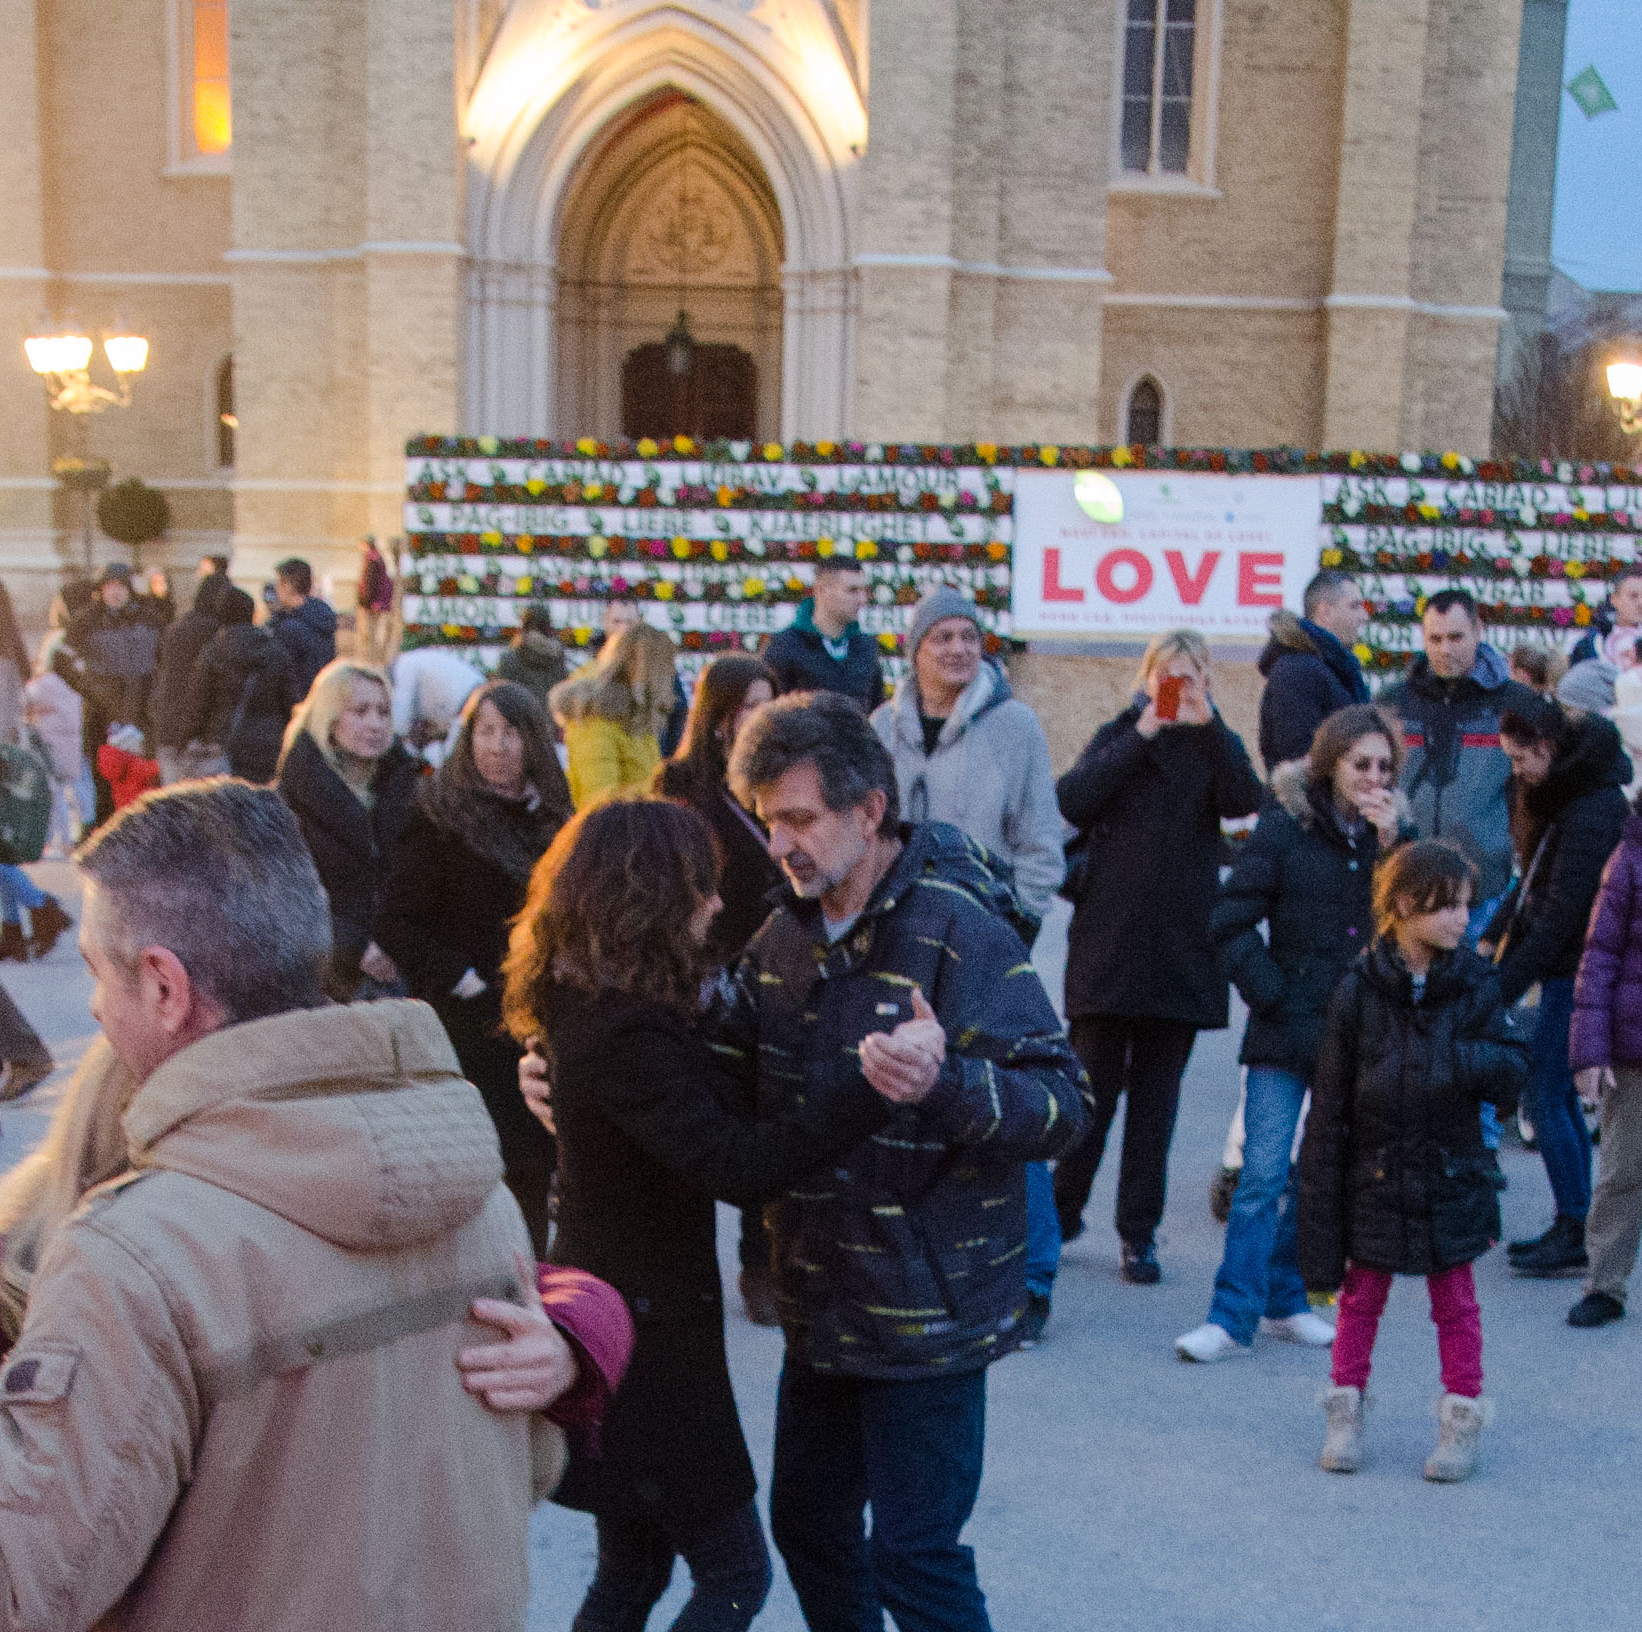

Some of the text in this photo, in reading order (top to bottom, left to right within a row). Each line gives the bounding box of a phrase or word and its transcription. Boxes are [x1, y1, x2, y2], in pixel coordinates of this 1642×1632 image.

[623, 511, 694, 532] LIEBE
[1543, 537, 1615, 560] LIEBE
[1042, 547, 1284, 607] LOVE
[418, 600, 774, 626] AMOR LIEBE
